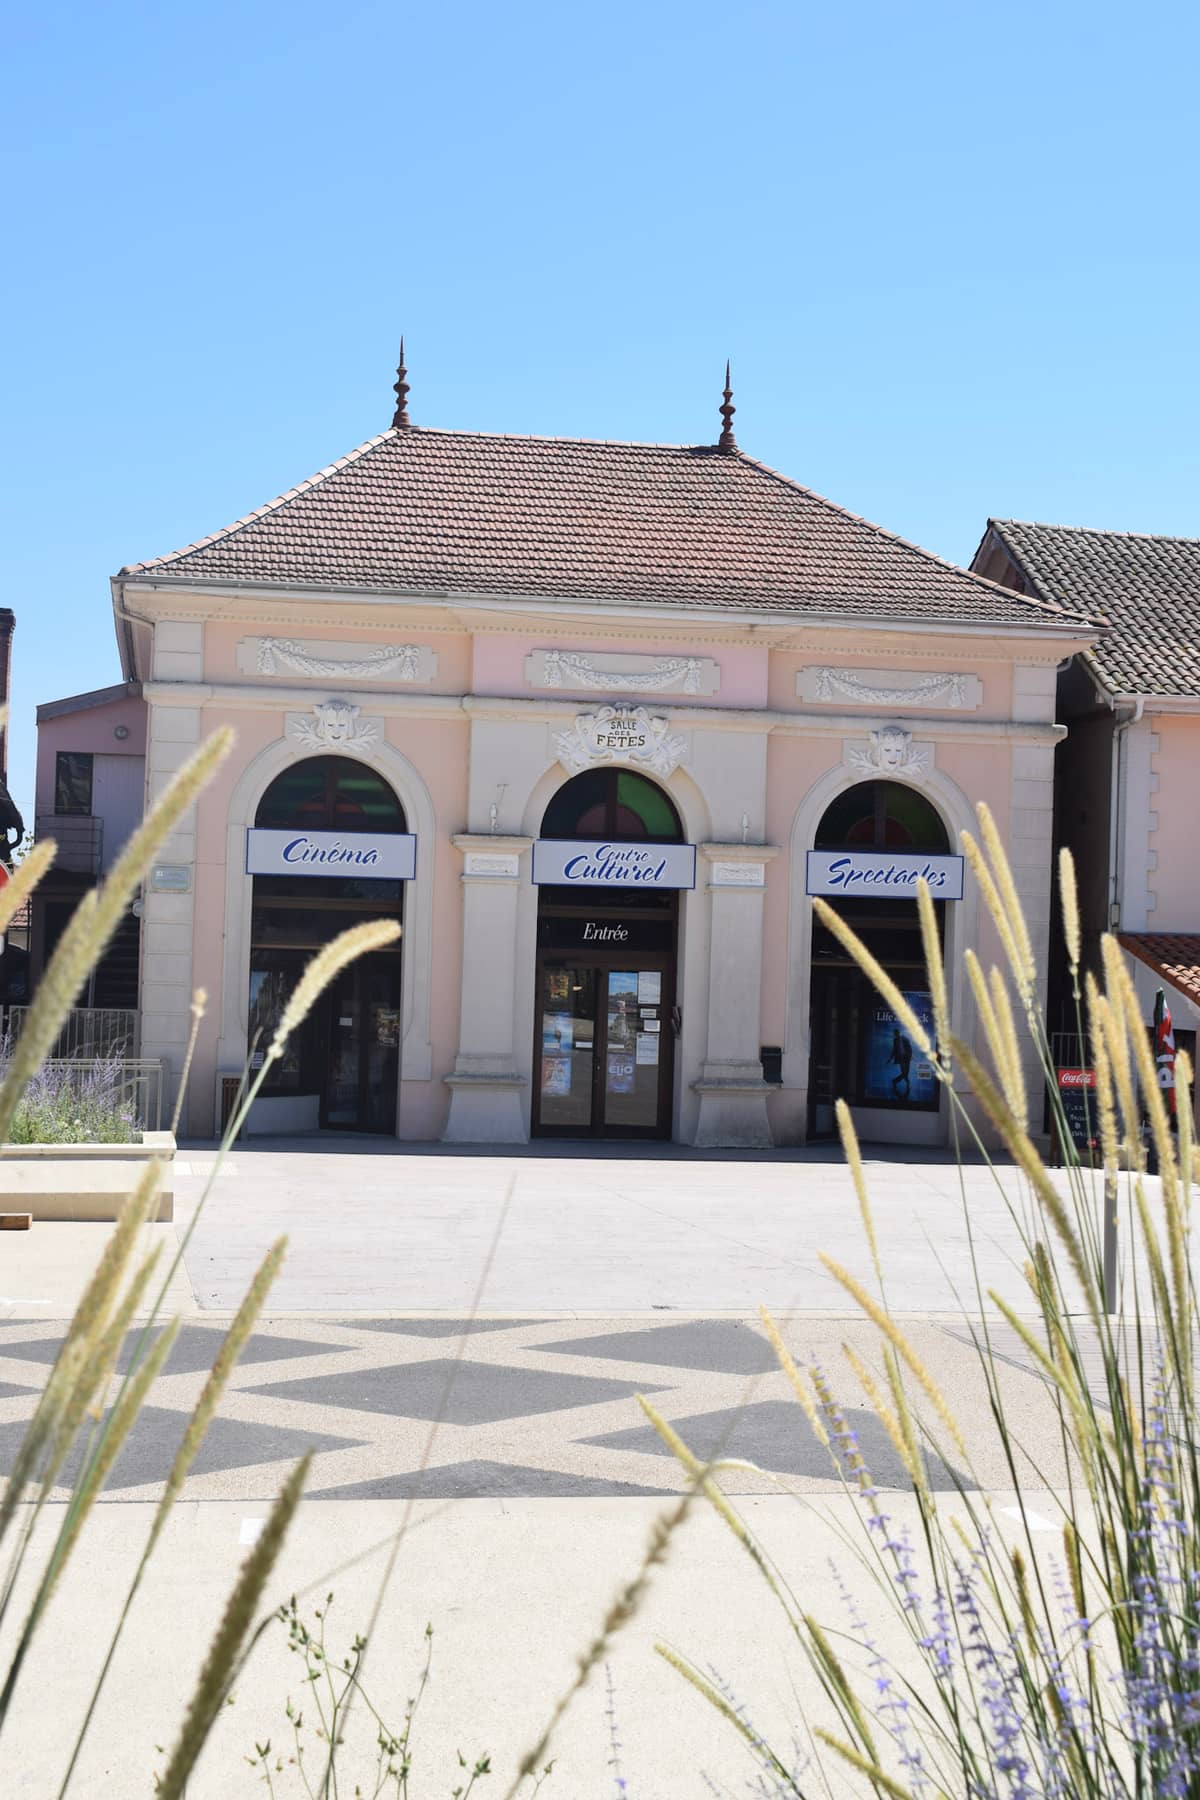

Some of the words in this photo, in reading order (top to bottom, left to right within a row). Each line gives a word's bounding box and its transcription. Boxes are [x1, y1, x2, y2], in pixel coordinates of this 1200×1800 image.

[610, 720, 637, 731] SALLE
[282, 837, 380, 865] Cinéma
[595, 844, 649, 862] Centre
[564, 855, 666, 881] Culturel
[828, 858, 947, 888] Spectacles
[583, 922, 629, 941] Entrée
